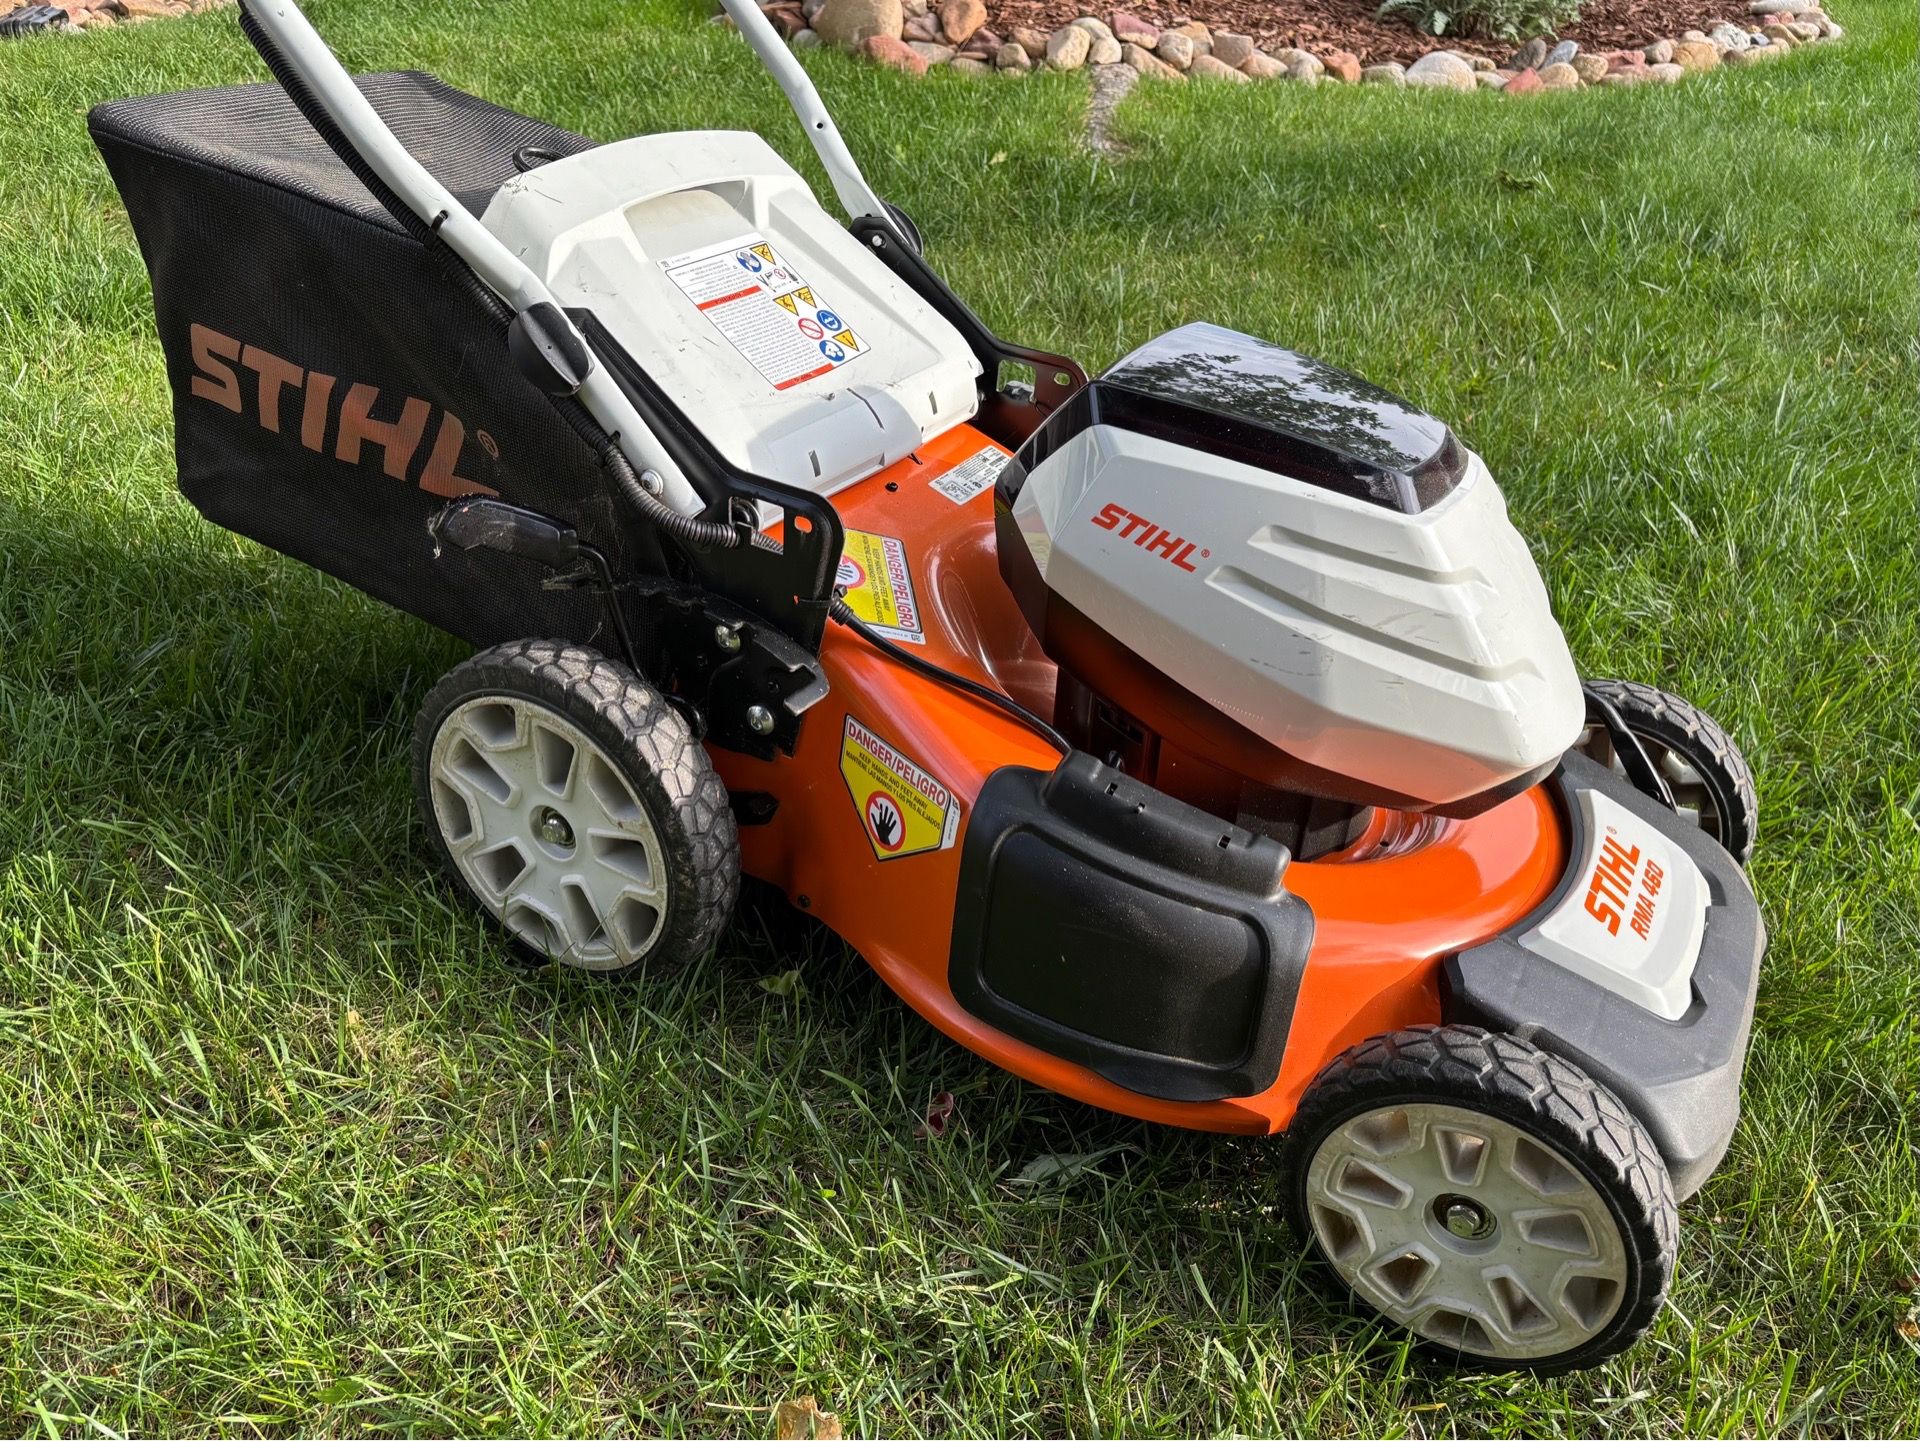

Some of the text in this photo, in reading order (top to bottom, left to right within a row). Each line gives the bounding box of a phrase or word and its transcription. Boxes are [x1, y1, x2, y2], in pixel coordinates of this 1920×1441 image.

[190, 323, 500, 498] STIHL
[1091, 503, 1197, 573] STIHL
[884, 540, 915, 628] DANGER/PELIGRO
[848, 722, 946, 807] DANGER/PELIGRO
[859, 752, 872, 765] KEEP
[889, 773, 900, 787] AND
[900, 782, 913, 798] FEET
[1584, 835, 1641, 937] STIHL
[1630, 858, 1664, 941] RMA 460
